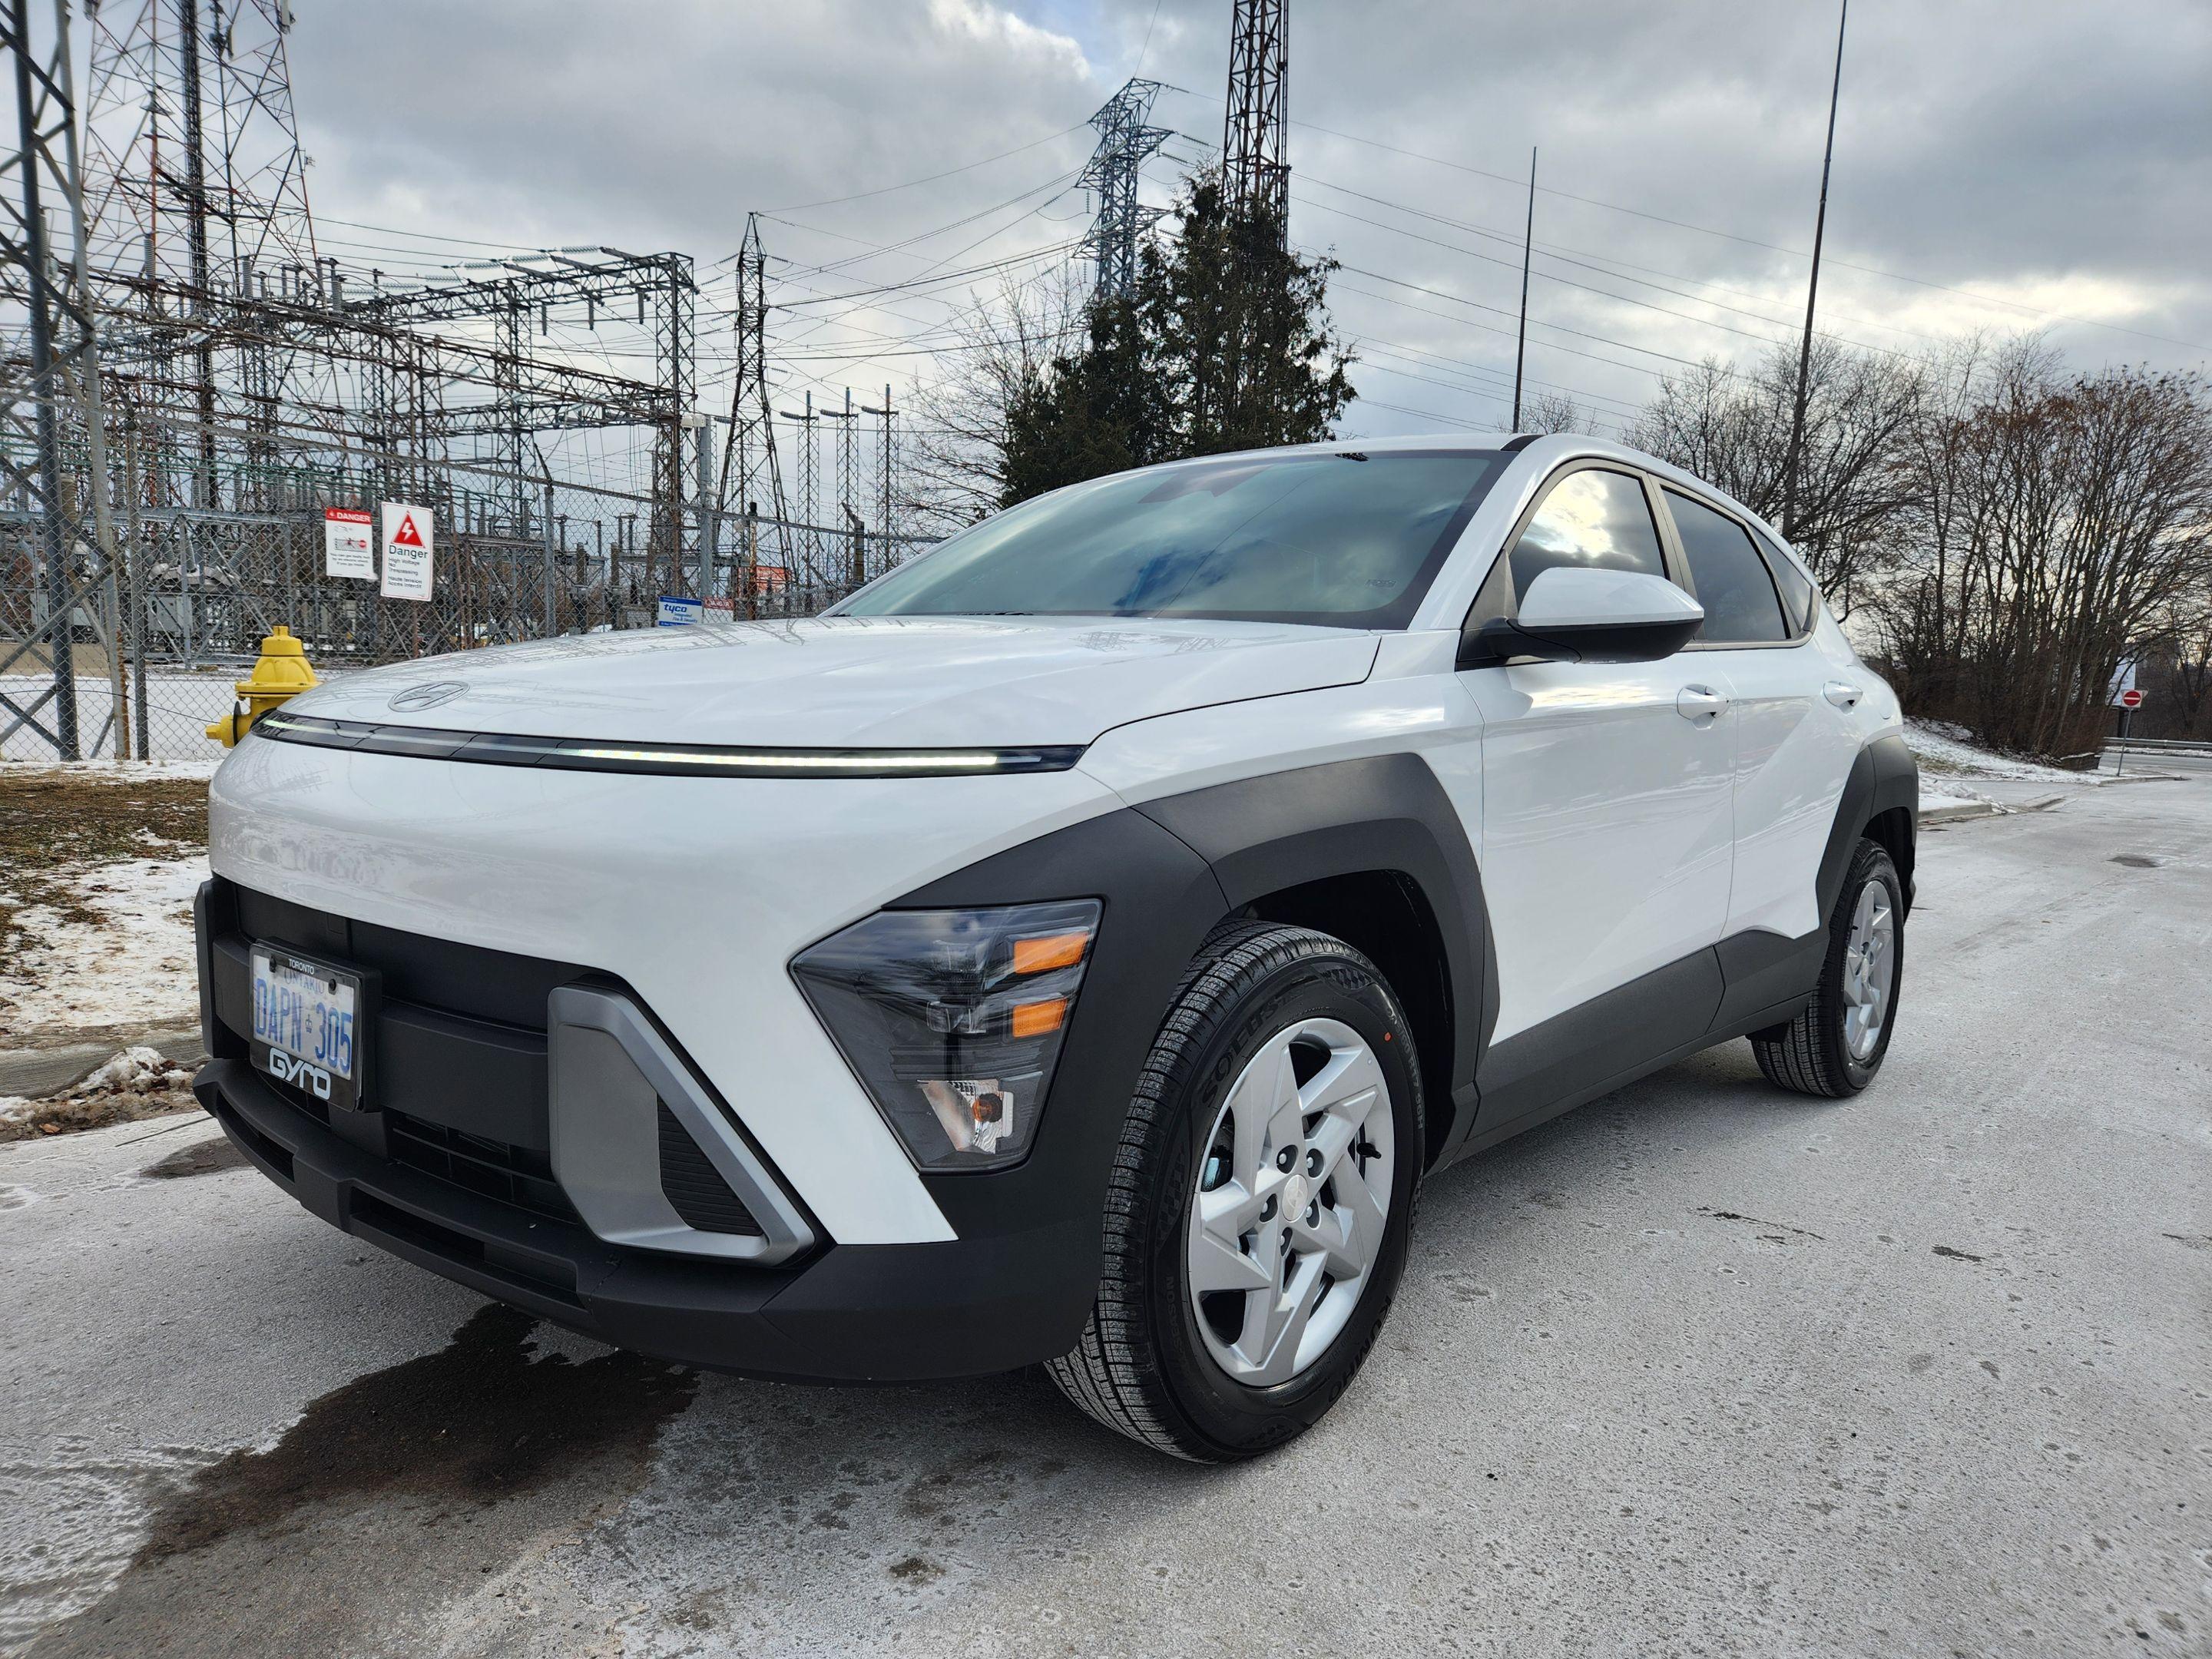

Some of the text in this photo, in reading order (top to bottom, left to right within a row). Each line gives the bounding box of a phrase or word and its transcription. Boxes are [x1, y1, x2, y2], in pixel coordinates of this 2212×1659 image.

[336, 512, 371, 522] DANGER
[389, 545, 428, 559] Danger
[389, 568, 419, 576] Trespassing
[664, 604, 687, 614] tyco
[288, 959, 315, 975] TORONTO
[283, 969, 325, 994] ONTARIO
[256, 978, 353, 1075] DAPN 305
[1328, 1294, 1392, 1402] KUMHO
